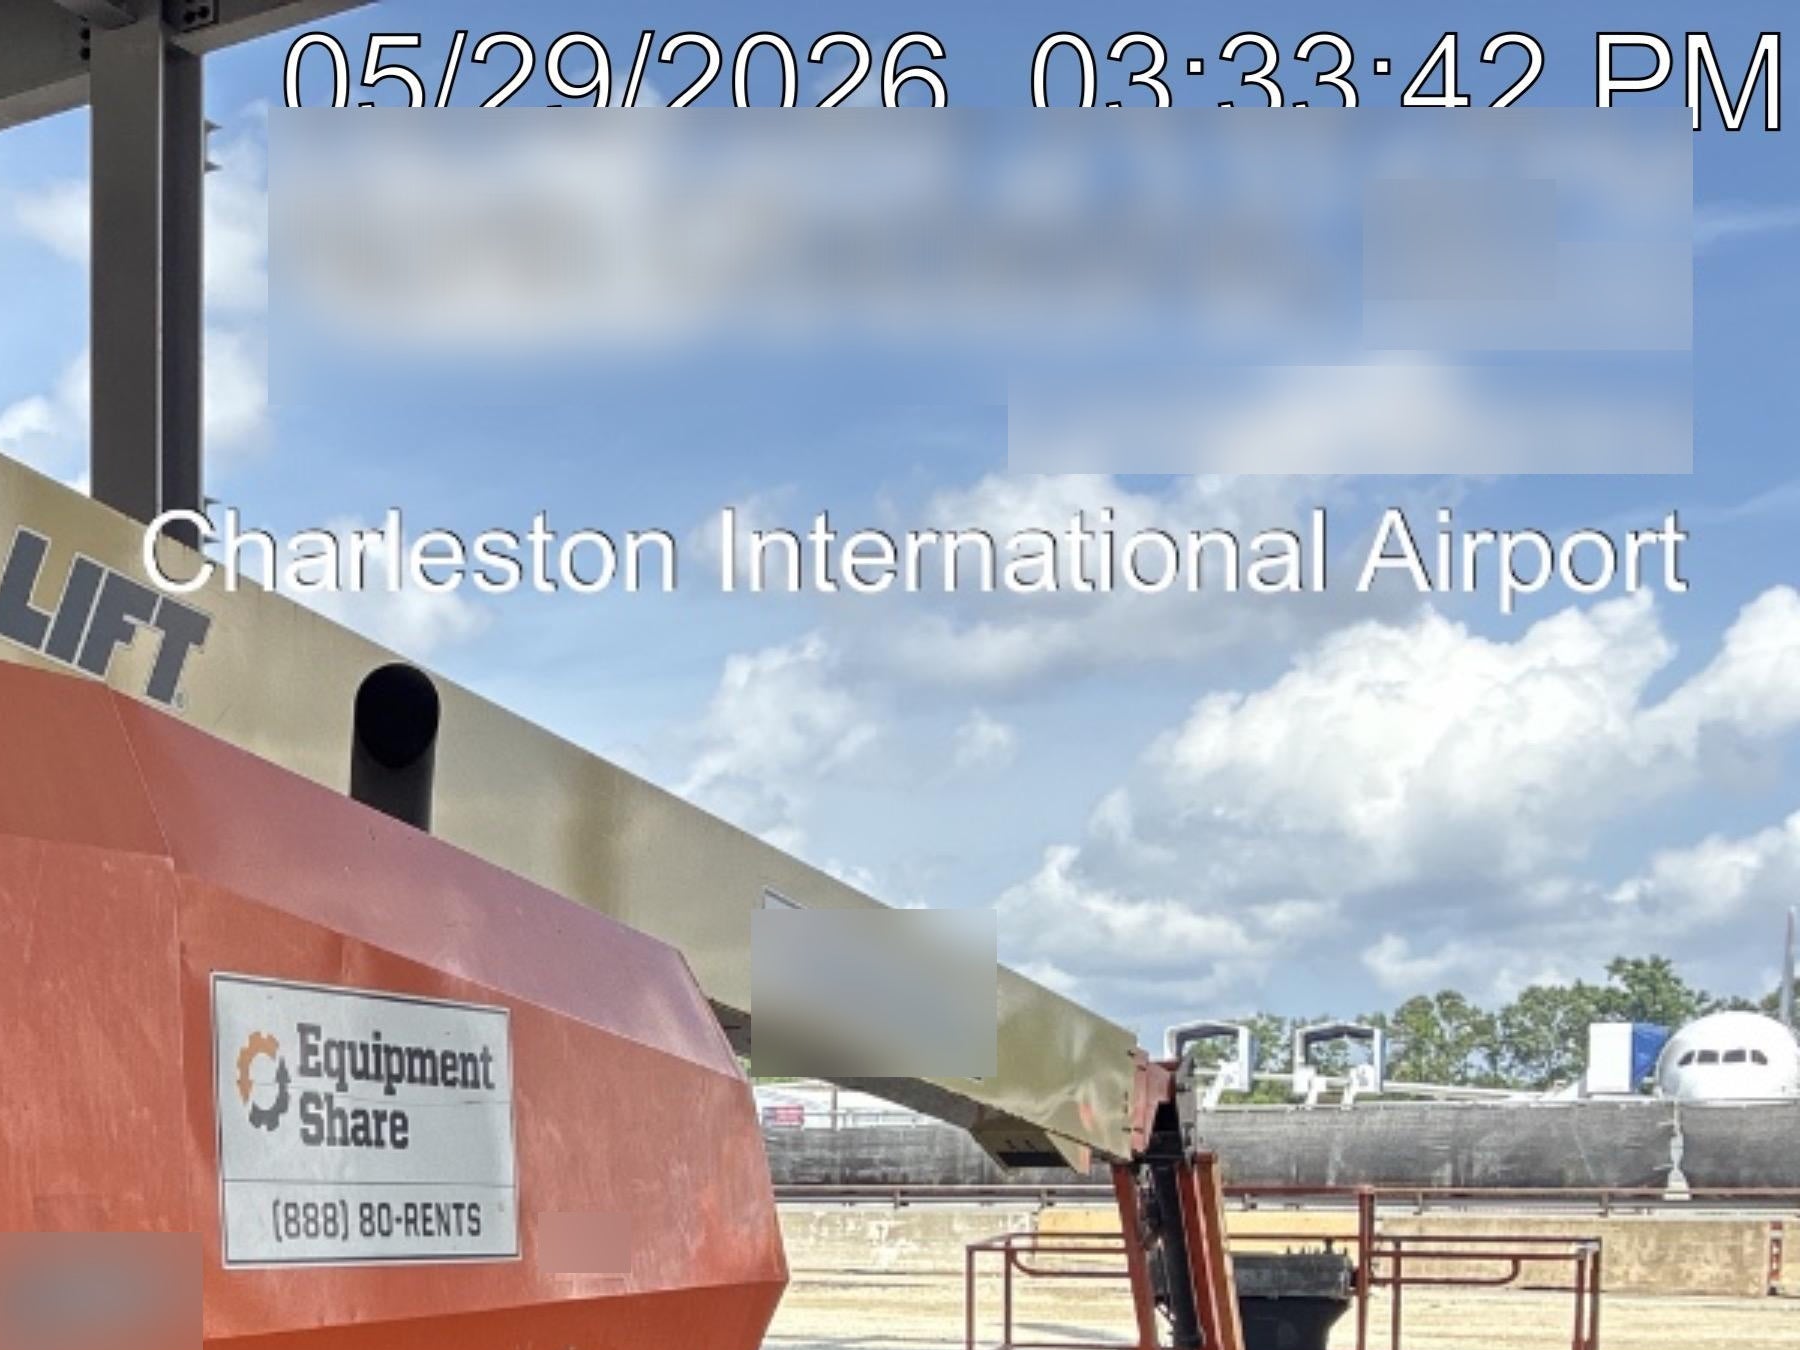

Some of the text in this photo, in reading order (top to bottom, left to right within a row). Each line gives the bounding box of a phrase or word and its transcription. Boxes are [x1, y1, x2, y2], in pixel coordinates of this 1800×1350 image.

[296, 1022, 495, 1096] Equipment
[299, 1091, 409, 1149] Share
[272, 1199, 481, 1242] (888) 80-RENTS
